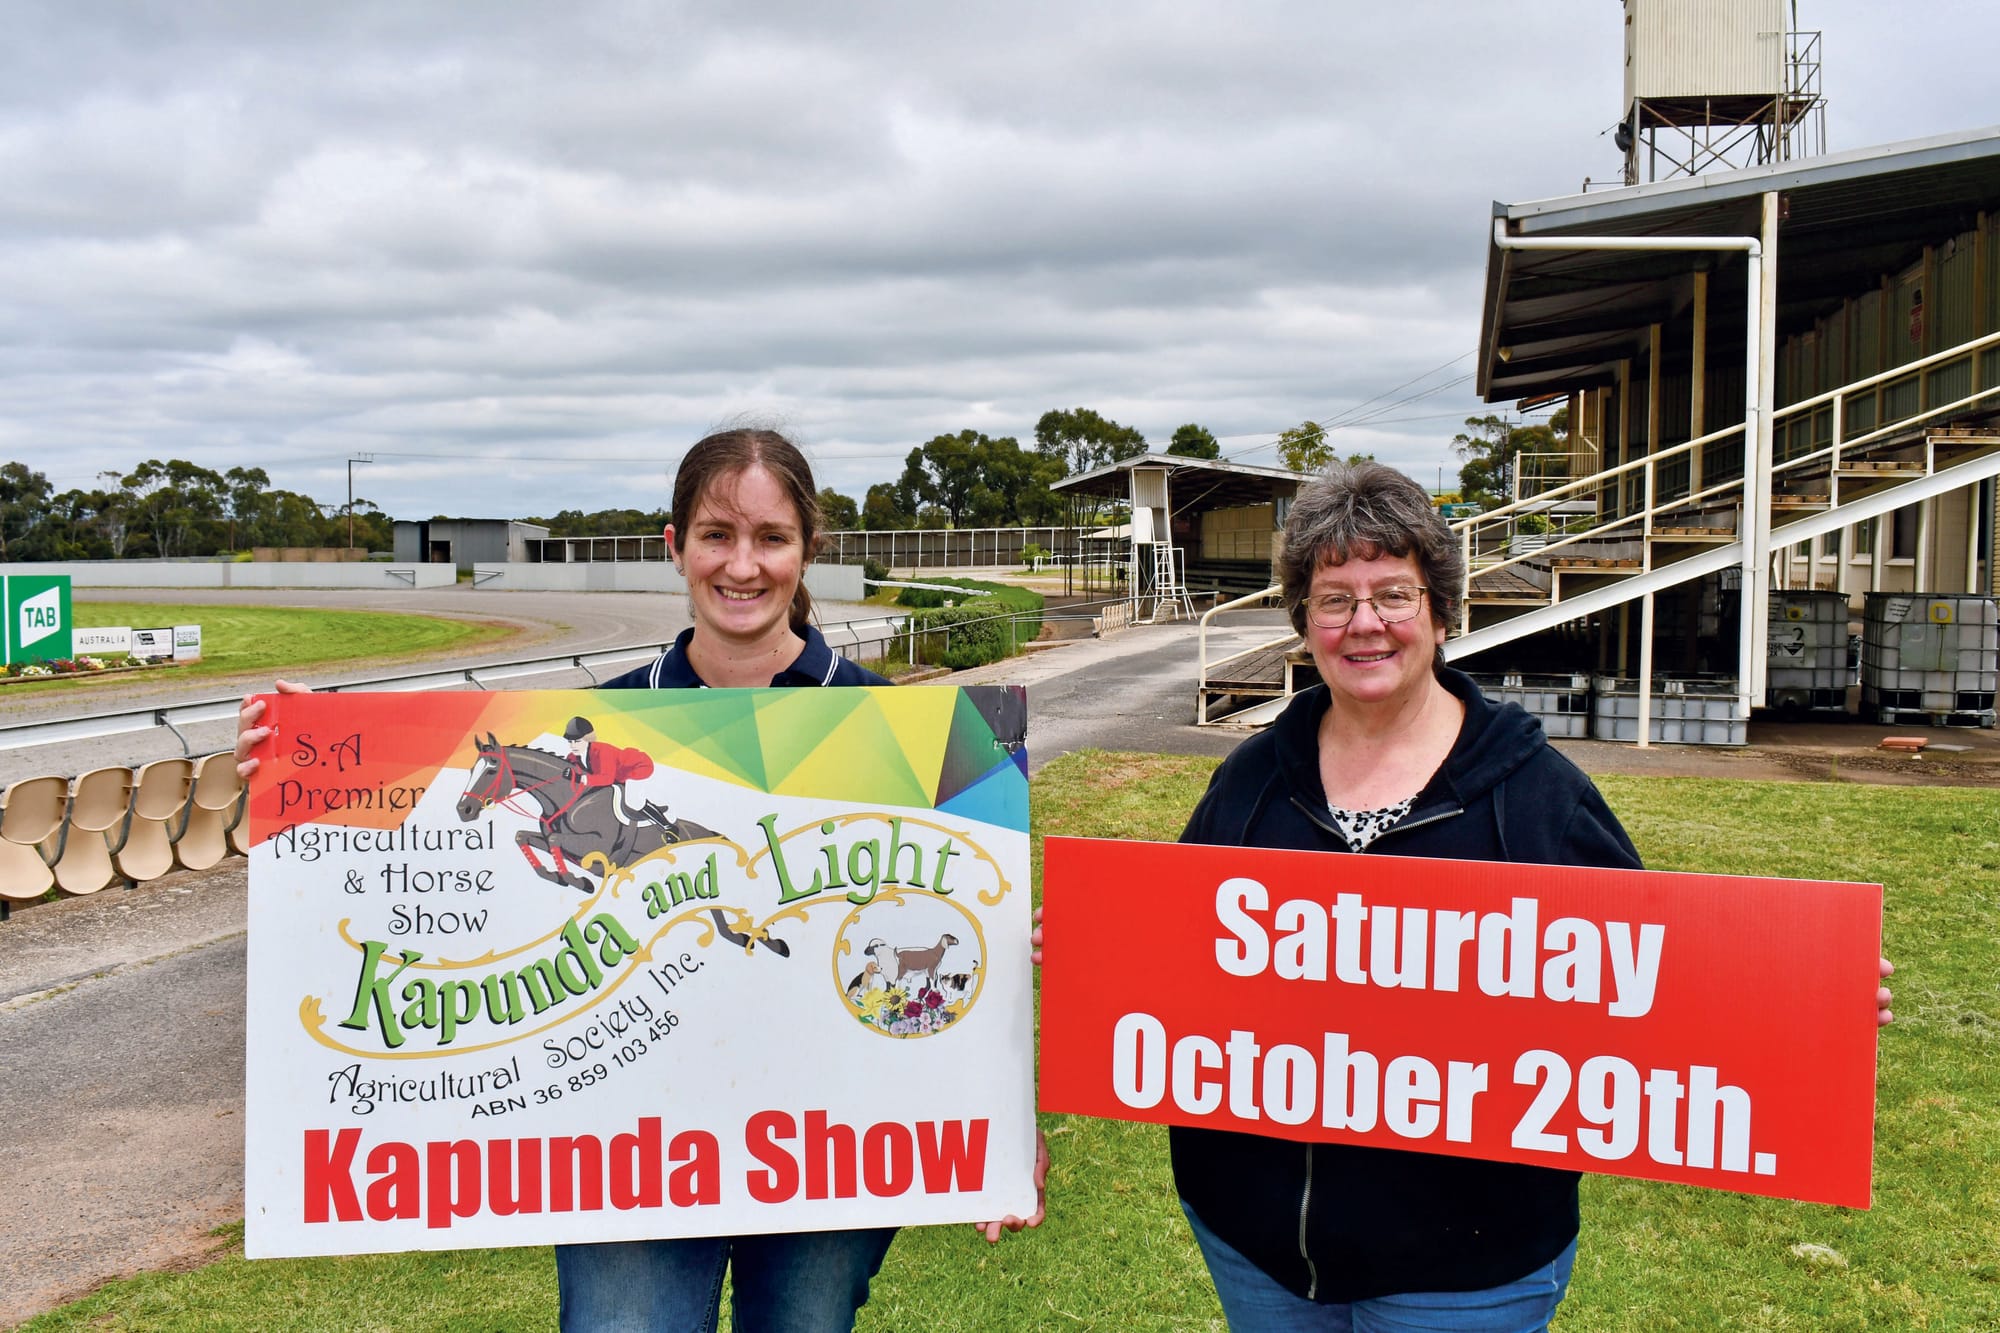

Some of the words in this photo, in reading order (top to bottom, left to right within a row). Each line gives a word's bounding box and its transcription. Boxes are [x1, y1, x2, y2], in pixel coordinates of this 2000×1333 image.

[25, 606, 56, 628] TAB
[80, 635, 125, 645] AUSTRALIA
[277, 780, 426, 816] Premier
[267, 820, 495, 862] Agricultural
[344, 869, 366, 894] &
[380, 863, 495, 895] Horse
[337, 912, 640, 1049] Kapunda
[642, 852, 720, 919] and
[756, 812, 961, 905] Light
[388, 904, 488, 935] Show
[1215, 877, 1665, 1018] Saturday
[328, 1057, 521, 1115] Agricultural
[543, 994, 654, 1069] Society
[647, 953, 705, 995] Inc.
[471, 1096, 527, 1119] ABN
[533, 1084, 564, 1105] 36
[567, 1063, 609, 1092] 859
[612, 1038, 648, 1069] 103
[647, 1010, 680, 1043] 456
[1112, 1012, 1488, 1143] October
[1511, 1049, 1777, 1176] 29th.
[304, 1117, 720, 1229] Kapunda
[745, 1110, 989, 1200] Show
